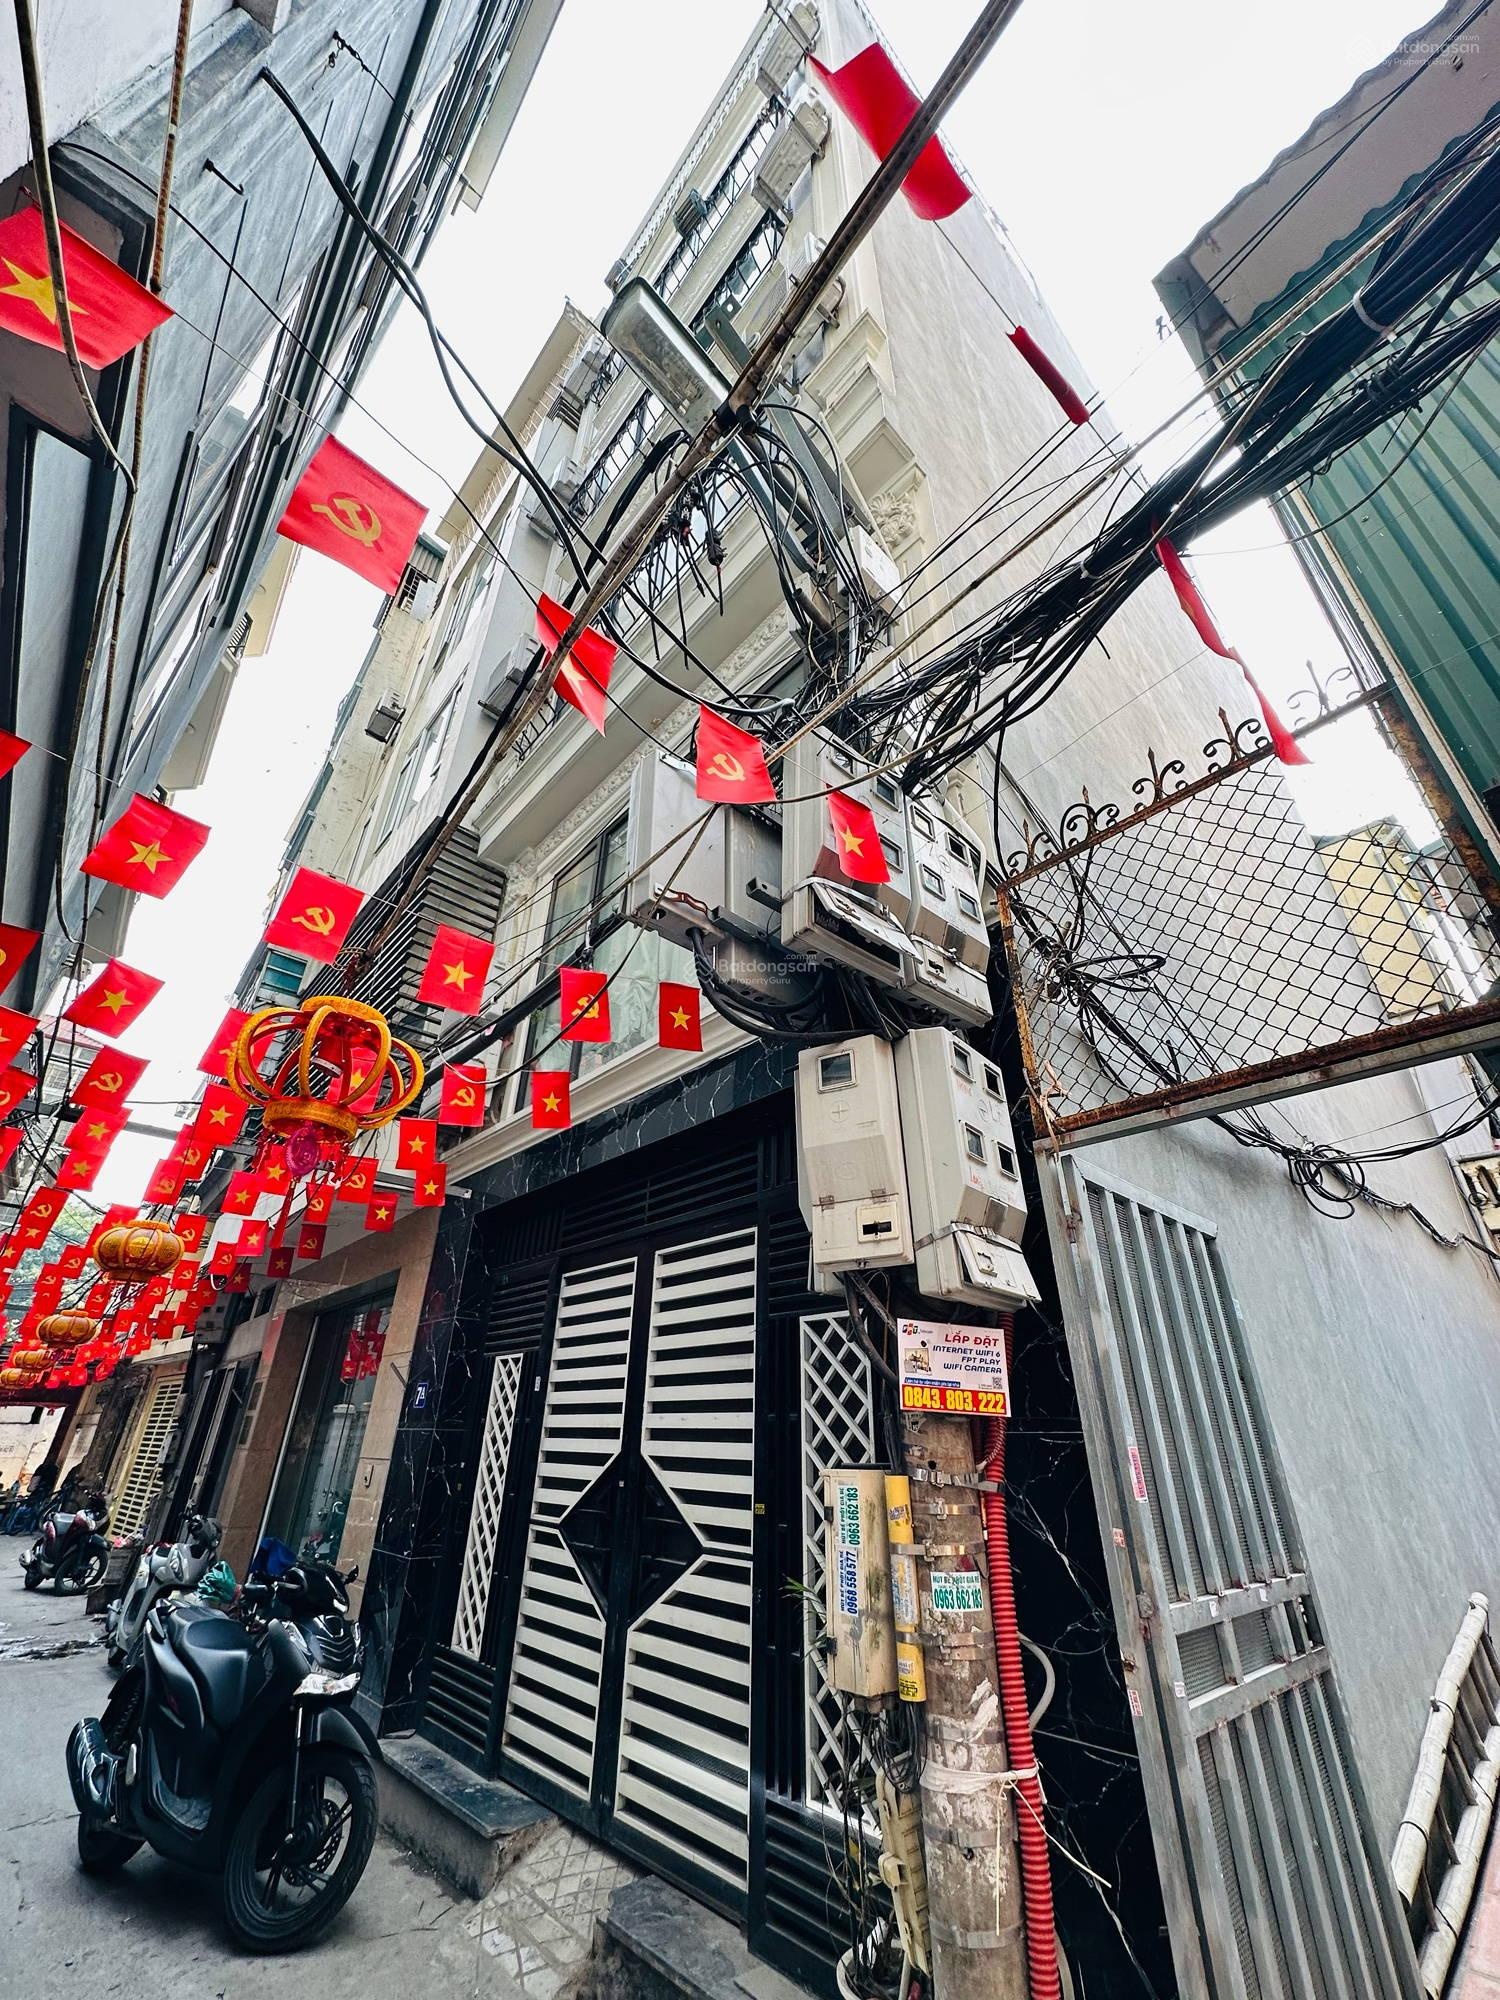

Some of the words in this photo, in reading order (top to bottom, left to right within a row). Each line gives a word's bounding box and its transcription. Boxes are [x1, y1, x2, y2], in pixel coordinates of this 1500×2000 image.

[945, 1330, 970, 1344] LẮP
[973, 1336, 999, 1348] ĐẶT
[933, 1345, 974, 1355] INTERNET
[961, 1356, 978, 1364] FPT
[979, 1358, 1001, 1366] PLAY
[943, 1363, 962, 1371] WIFI
[964, 1365, 1002, 1374] CAMERA
